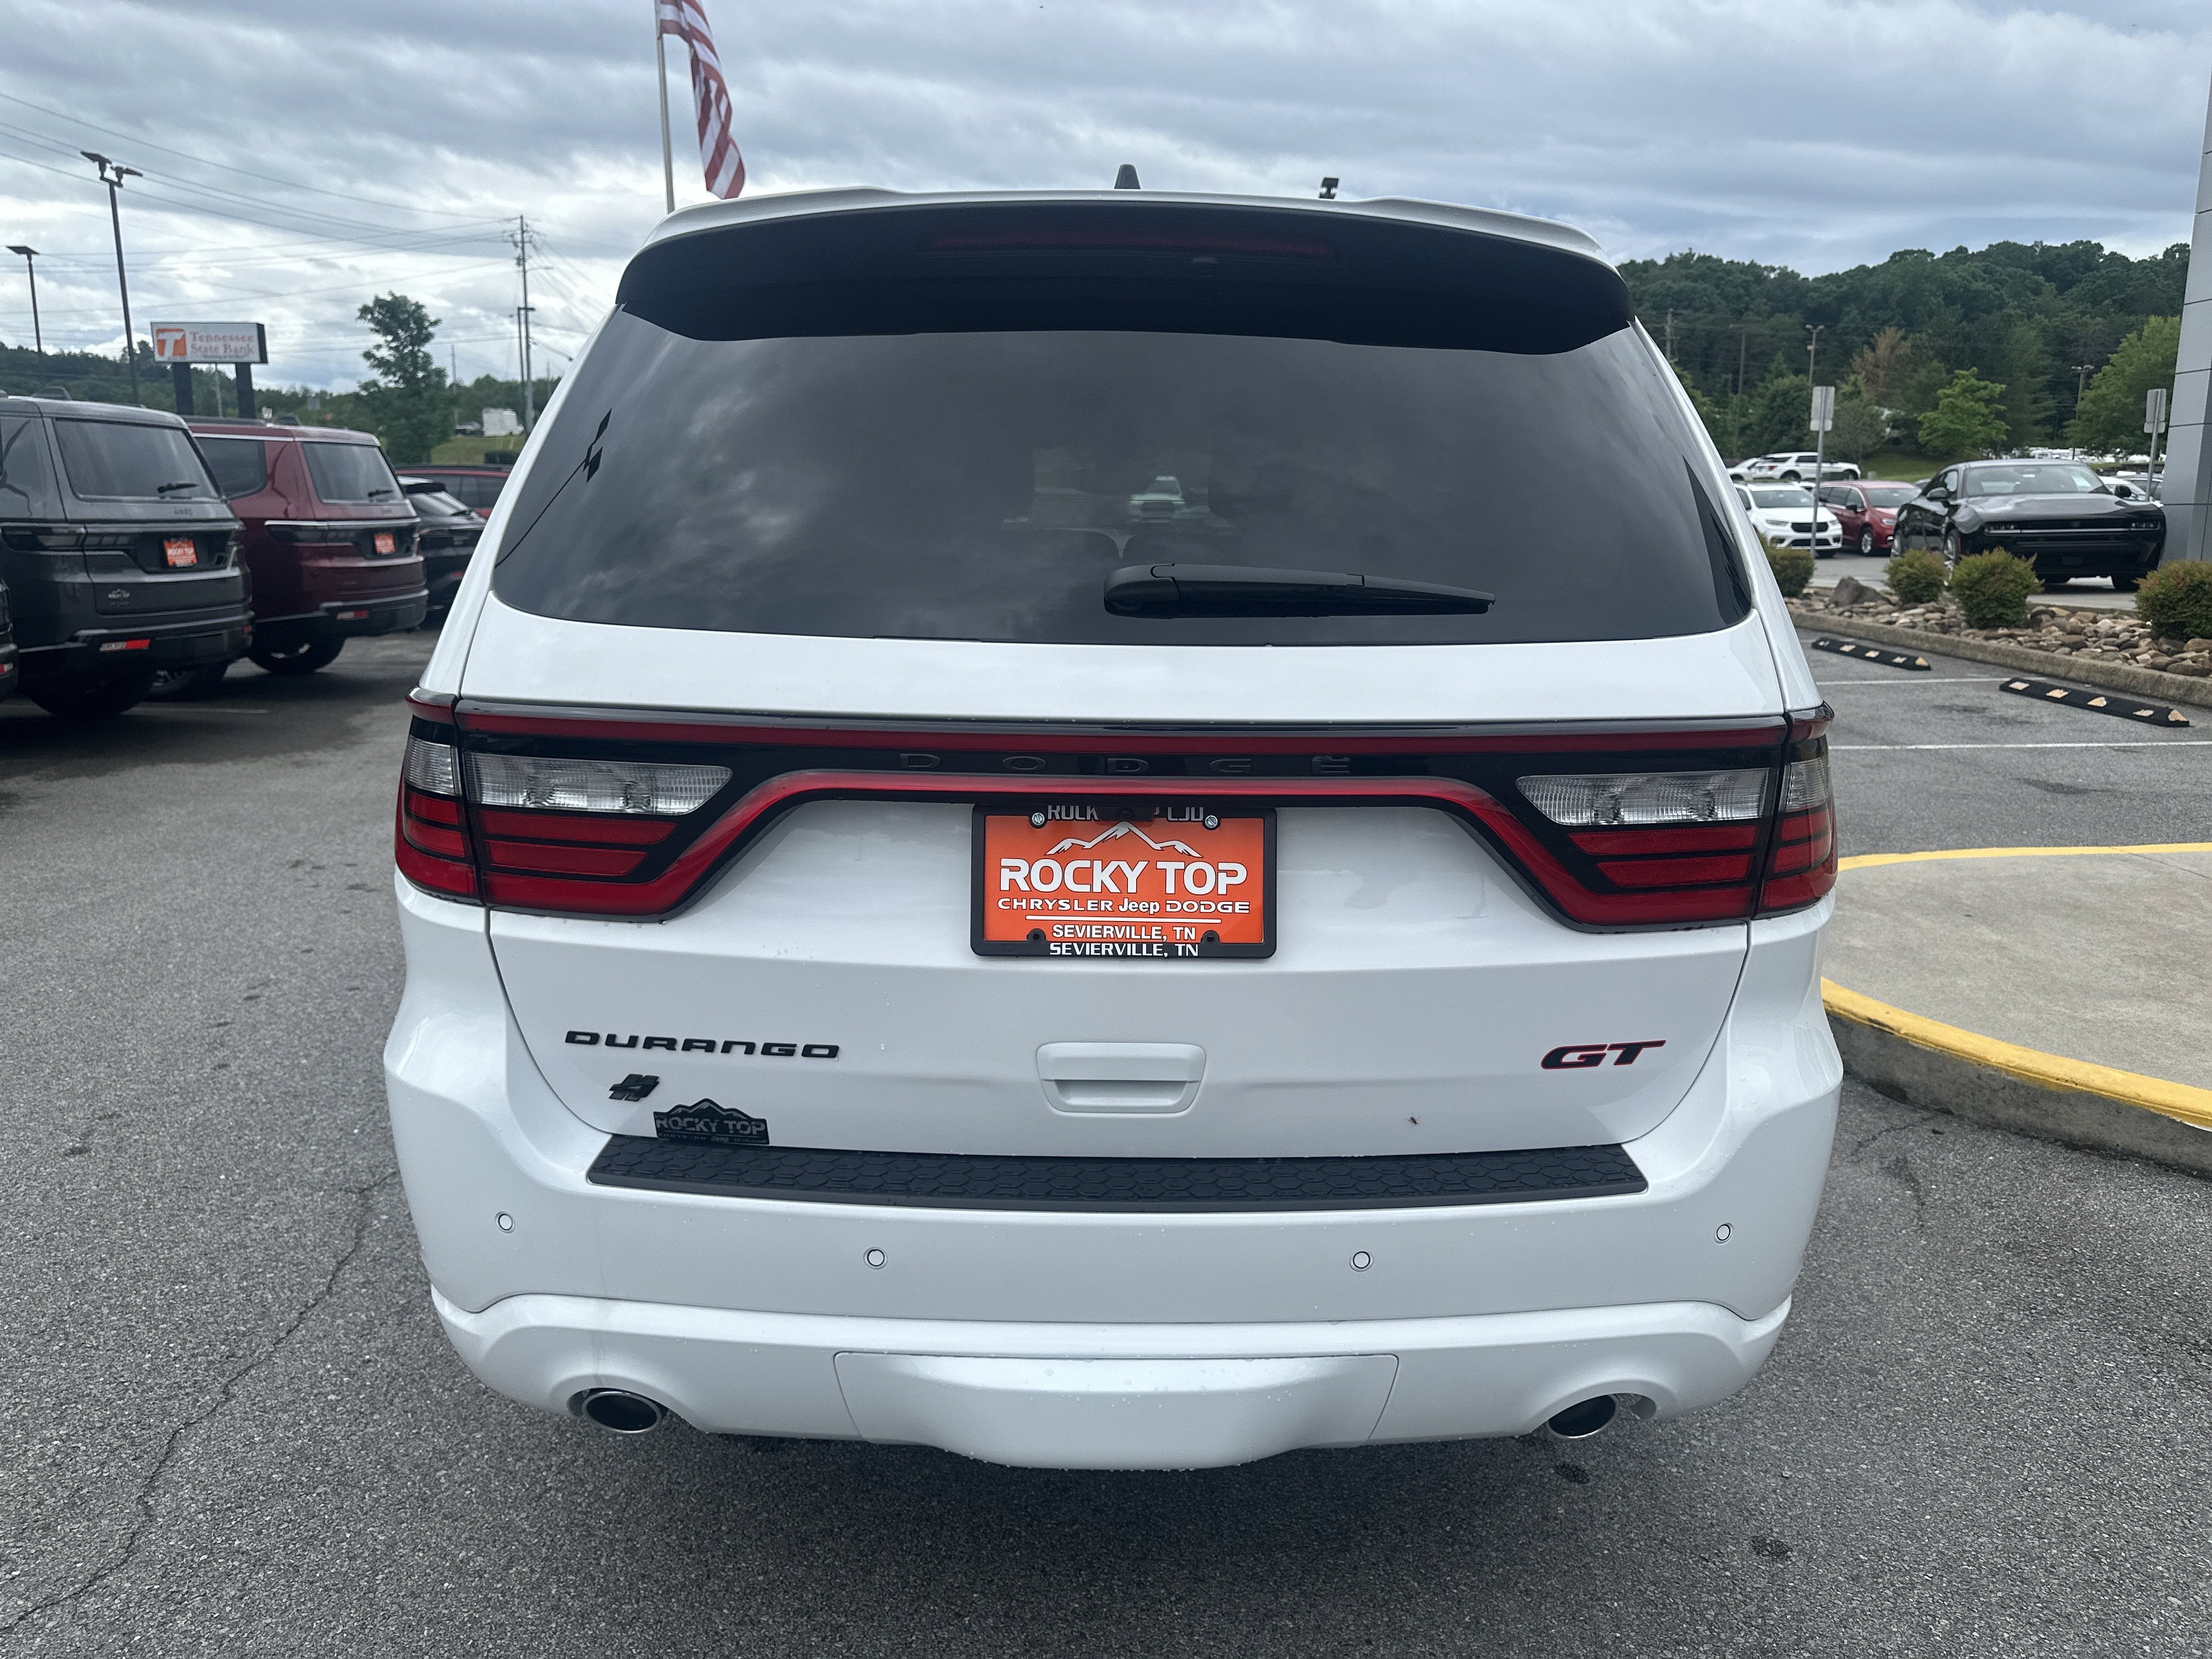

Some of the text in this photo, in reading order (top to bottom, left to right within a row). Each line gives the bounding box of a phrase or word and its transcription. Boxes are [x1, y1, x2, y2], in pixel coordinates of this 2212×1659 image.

[189, 331, 254, 342] Tennessee
[900, 753, 1350, 774] DODGE
[1047, 805, 1099, 821] ROCK
[1000, 858, 1248, 895] ROCKY TOP
[997, 897, 1250, 915] CHRYSLER Jeep DODGE
[1052, 924, 1196, 942] SEVIERVILLE, TN
[1049, 943, 1199, 958] SEVIERVILLE, TN
[565, 1030, 839, 1058] DURANGO
[1541, 1040, 1667, 1070] GT
[656, 1116, 766, 1135] ROCKY TOP
